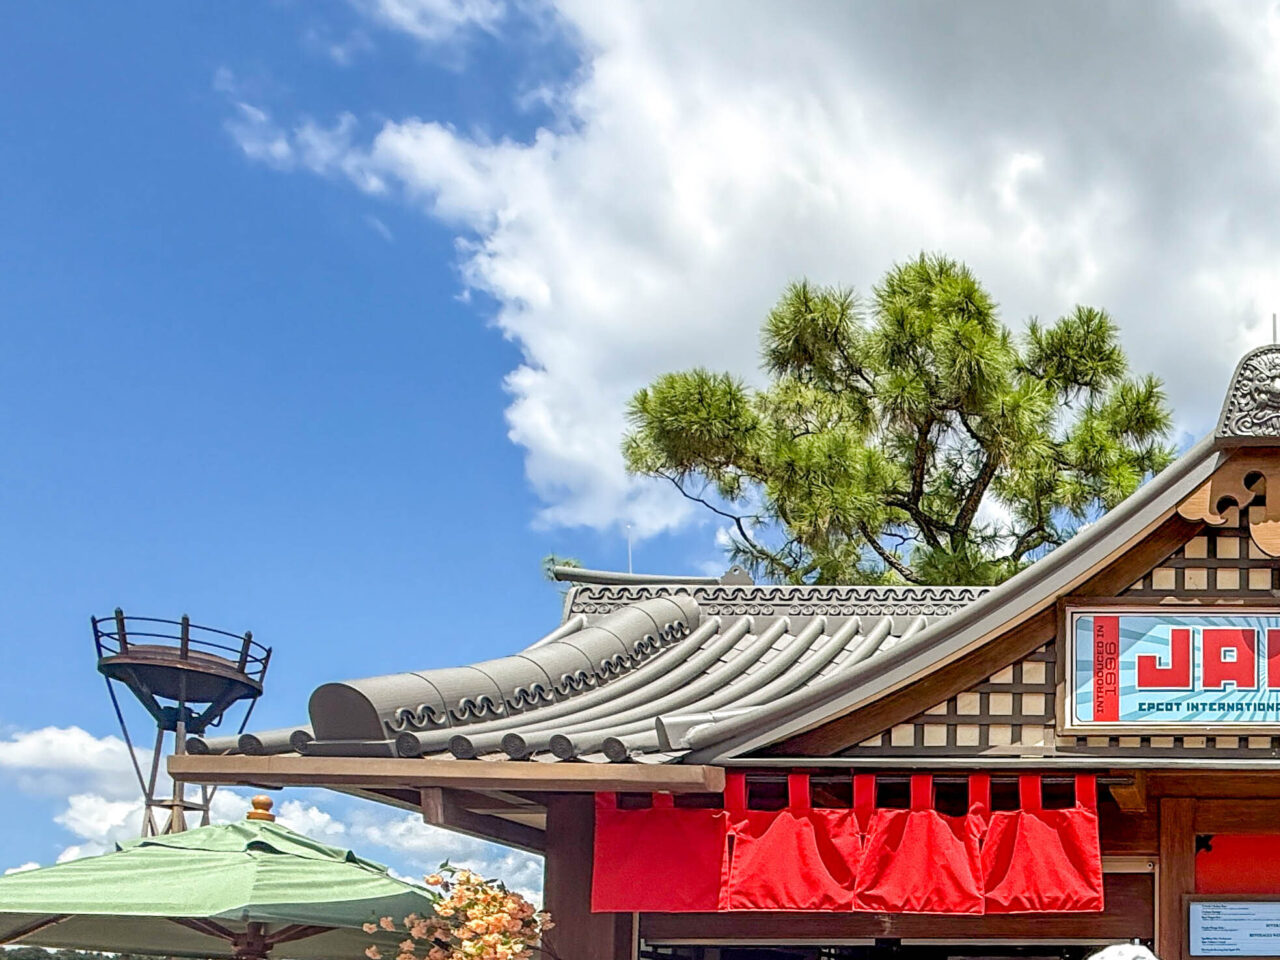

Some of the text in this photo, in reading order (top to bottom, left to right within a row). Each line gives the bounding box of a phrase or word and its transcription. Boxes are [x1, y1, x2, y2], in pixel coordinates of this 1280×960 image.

[1096, 624, 1104, 714] INTRODUCED IN
[1104, 641, 1117, 696] 1996
[1138, 702, 1182, 712] EPCOT
